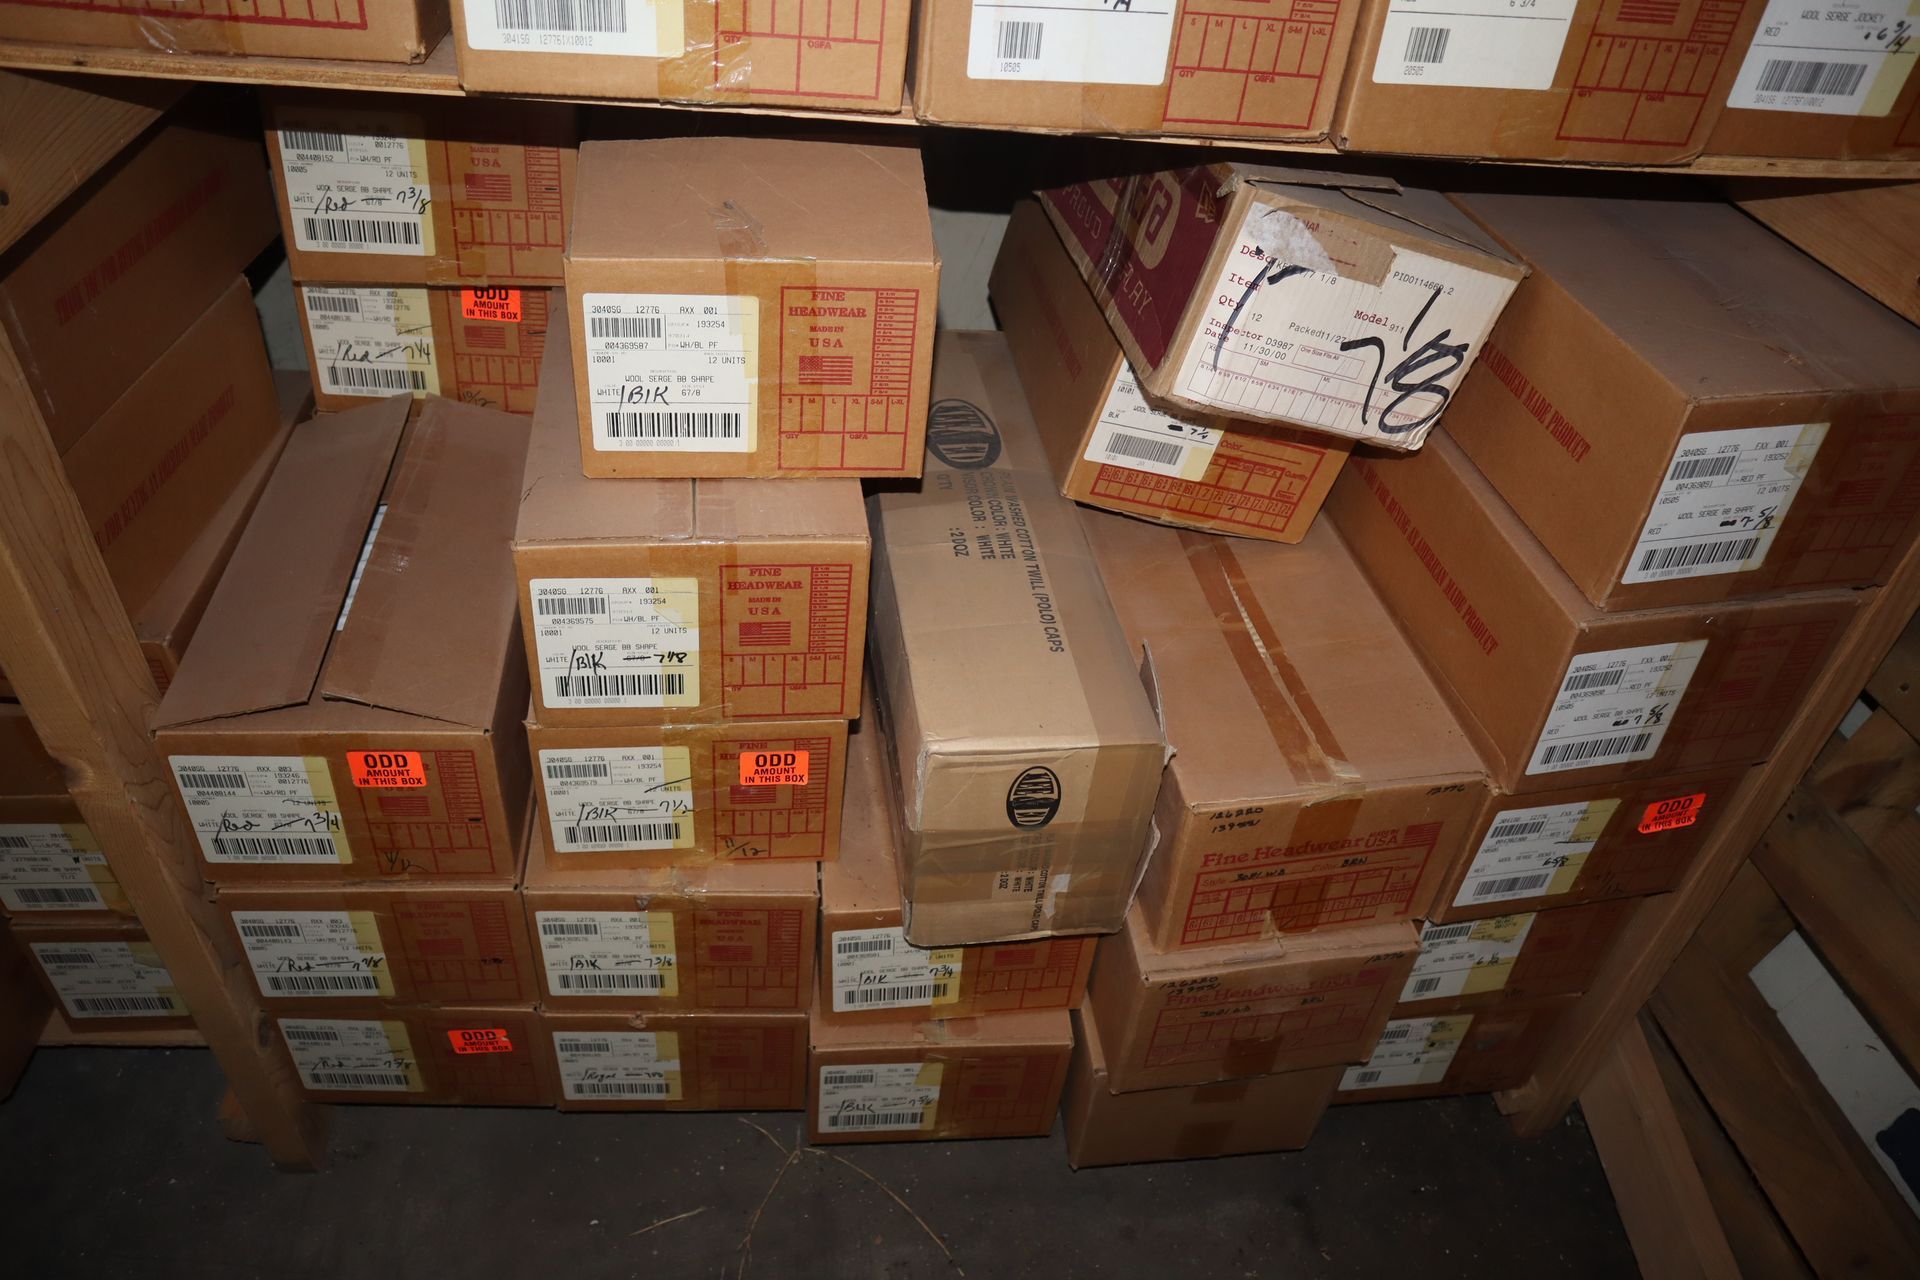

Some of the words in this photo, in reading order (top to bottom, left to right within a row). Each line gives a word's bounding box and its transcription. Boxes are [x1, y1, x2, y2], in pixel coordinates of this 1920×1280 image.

[1801, 10, 1820, 21] WOOL
[1825, 11, 1851, 22] SERGE
[1854, 12, 1887, 23] JOCKEY
[1764, 27, 1781, 37] RED
[471, 157, 502, 168] USA
[384, 170, 394, 178] 12
[396, 170, 418, 178] UNITS
[293, 195, 314, 204] WHITE
[1228, 272, 1261, 292] Item
[811, 291, 845, 302] FINE
[474, 300, 510, 311] AMOUNT
[1218, 294, 1245, 312] Qty
[466, 308, 476, 317] IN
[478, 309, 498, 319] THIS
[500, 311, 518, 320] BOX
[592, 305, 622, 314] 3040SG
[635, 306, 660, 314] 12776
[679, 306, 695, 315] AXX
[703, 306, 718, 315] 001
[788, 306, 868, 318] HEADWEAR
[1251, 312, 1264, 323] 12
[1354, 309, 1389, 328] Model
[696, 320, 726, 328] 193254
[1210, 317, 1264, 341] Inspector
[1265, 337, 1295, 352] D3987
[604, 342, 649, 350] 004369587
[708, 341, 719, 350] PF
[808, 338, 844, 348] USA
[1204, 328, 1230, 343] Date
[1242, 342, 1288, 361] 11/30/00
[592, 356, 616, 364] 10001
[708, 356, 718, 365] 12
[721, 356, 746, 365] UNITS
[624, 374, 644, 383] WOOL
[648, 374, 673, 384] SERGE
[676, 375, 688, 384] BB
[690, 374, 715, 384] SHAPE
[597, 388, 621, 397] WHITE
[681, 388, 701, 398] 67/8
[1108, 410, 1120, 420] BLK
[1220, 439, 1244, 450] Color
[1740, 474, 1754, 482] RED
[1768, 484, 1790, 494] UNITS
[967, 495, 986, 522] COLOR
[1005, 495, 1027, 527] WASHED
[1648, 527, 1662, 536] RED
[976, 534, 996, 560] WHITE
[996, 531, 1016, 560] WHITE
[1016, 528, 1038, 562] COTTON
[748, 568, 782, 576] FINE
[1025, 562, 1045, 591] TWILL
[538, 587, 566, 595] 3040SG
[580, 586, 604, 594] 12776
[622, 586, 637, 594] AXX
[645, 586, 660, 594] 001
[728, 581, 804, 590] HEADWEAR
[748, 606, 782, 615] USA
[1032, 592, 1057, 625] (POLO)
[1462, 603, 1498, 656] PRODUCT
[1044, 626, 1065, 653] CAPS
[738, 742, 768, 750] FINE
[363, 754, 408, 770] ODD
[755, 754, 797, 768] ODD
[366, 768, 412, 778] AMOUNT
[753, 766, 796, 777] AMOUNT
[358, 777, 370, 786] IN
[373, 776, 400, 786] THIS
[401, 776, 424, 786] BOX
[744, 774, 757, 784] IN
[759, 774, 782, 784] THIS
[785, 773, 806, 784] BOX
[1656, 798, 1694, 814] ODD
[1652, 808, 1690, 822] AMOUNT
[1642, 822, 1652, 832] IN
[1653, 819, 1674, 831] THIS
[1202, 852, 1248, 868] Fine
[1252, 836, 1365, 861] Headwear
[1364, 836, 1399, 849] USA
[461, 1031, 498, 1041] ODD
